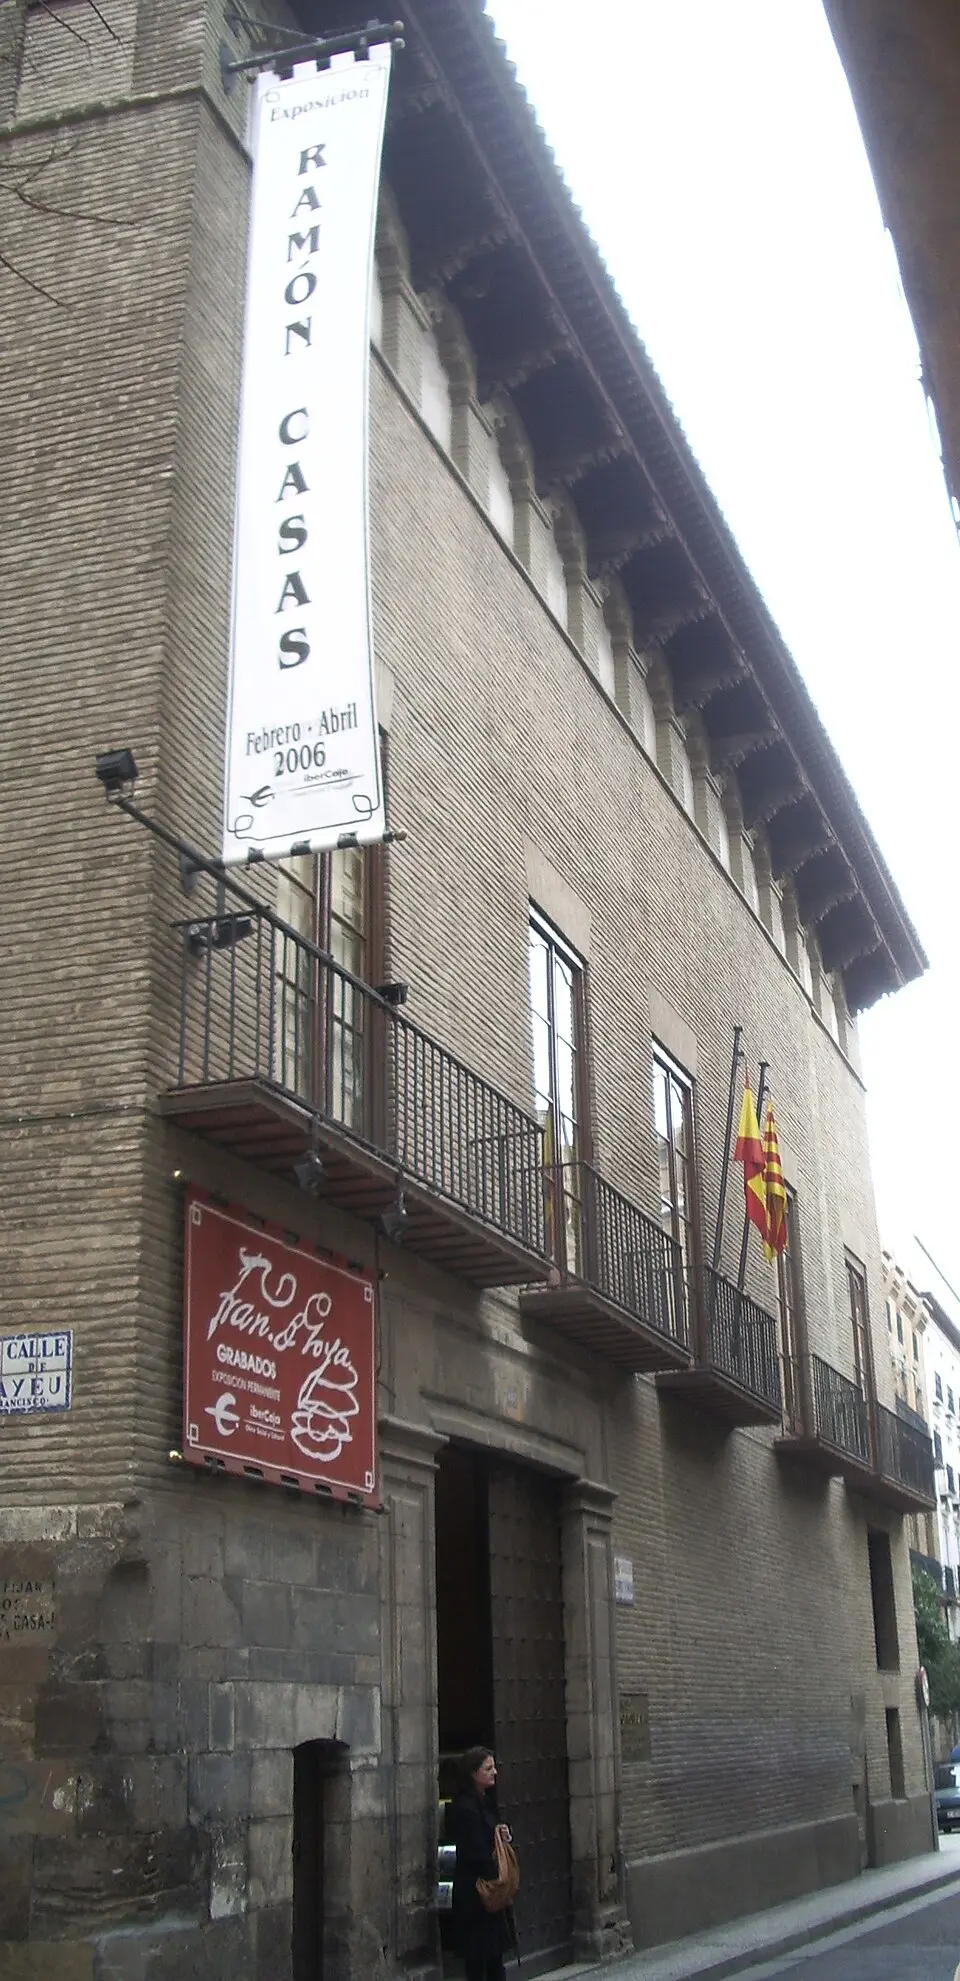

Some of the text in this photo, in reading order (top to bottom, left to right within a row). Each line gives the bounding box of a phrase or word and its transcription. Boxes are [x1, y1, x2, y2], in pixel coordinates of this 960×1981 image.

[283, 142, 328, 357] RAMÓN
[274, 407, 313, 671] CASAS
[245, 722, 301, 756] Febrero
[319, 702, 358, 736] Abril
[273, 741, 326, 777] 2006
[6, 1338, 65, 1360] CALLE
[28, 1362, 47, 1373] DE
[216, 1343, 277, 1380] GRABADOS
